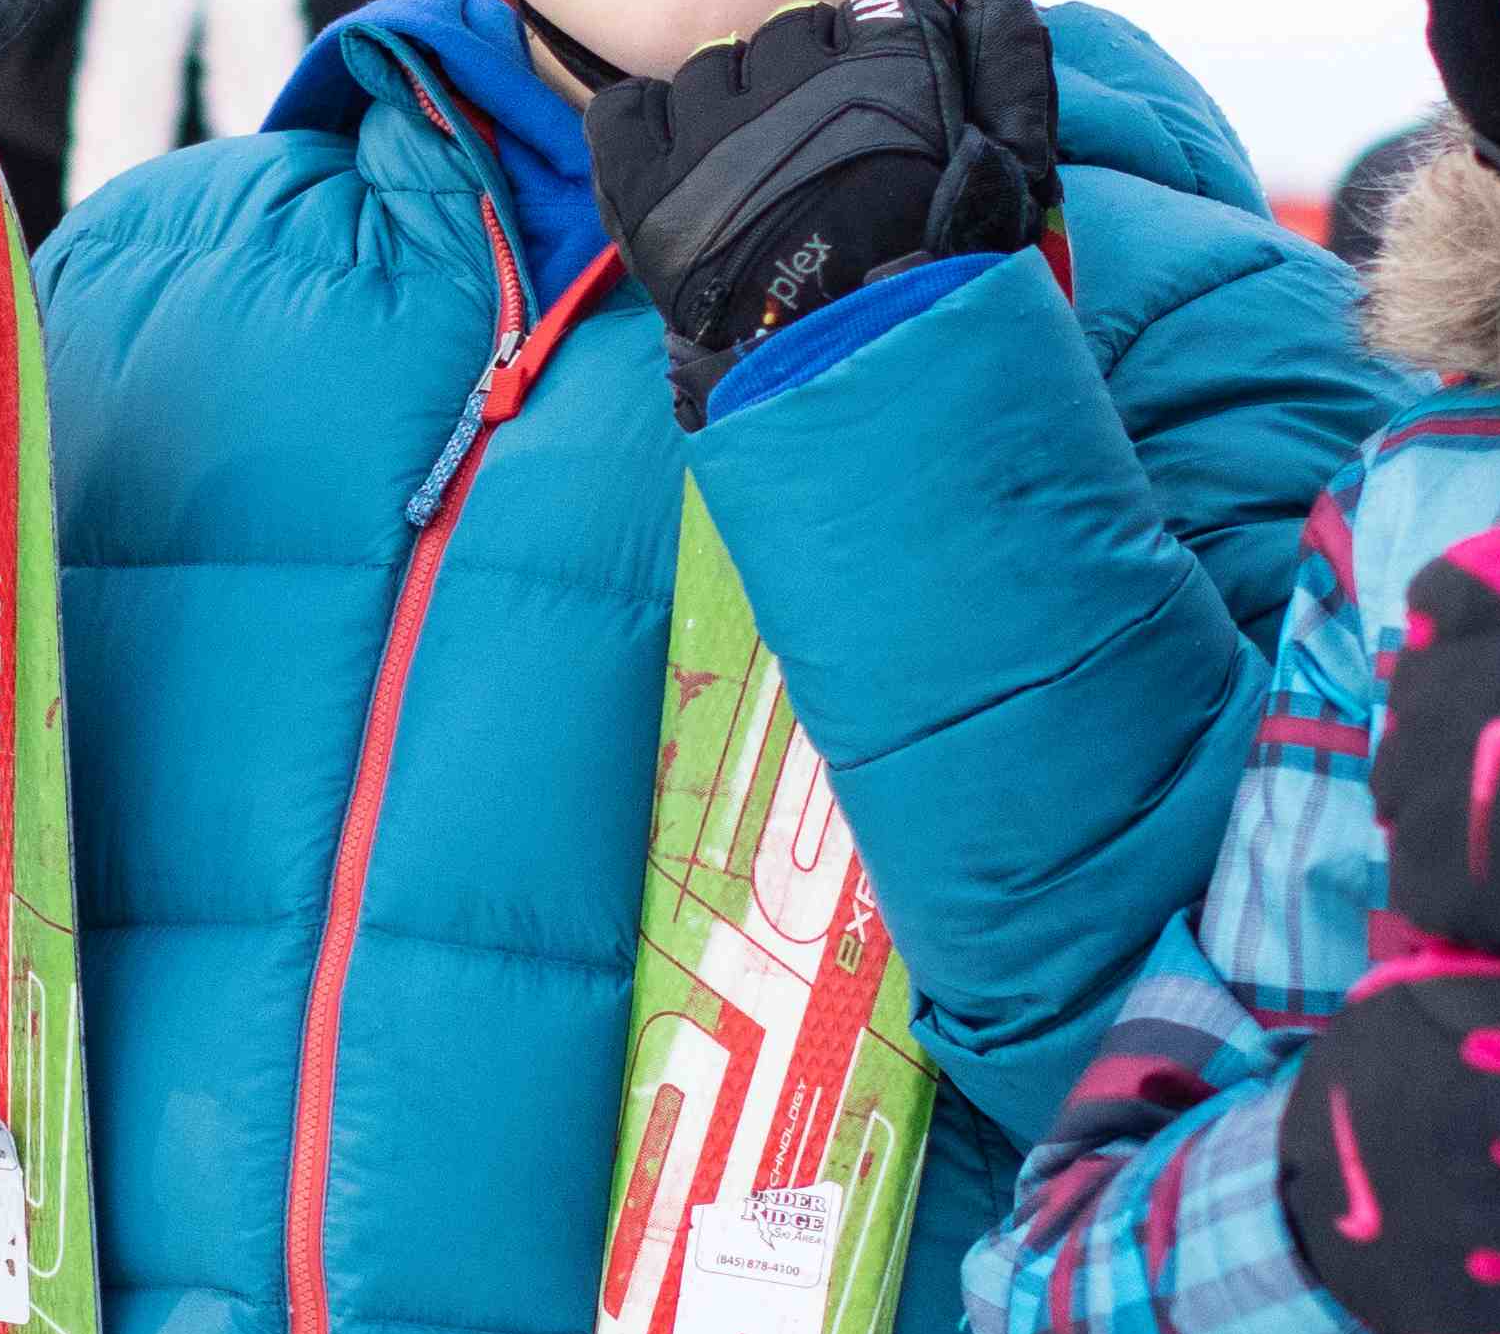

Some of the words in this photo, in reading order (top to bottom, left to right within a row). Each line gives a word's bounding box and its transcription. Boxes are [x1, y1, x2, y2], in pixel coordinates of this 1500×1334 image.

[769, 1077, 808, 1189] CHNOLOGY
[740, 1195, 826, 1232] RIDGE
[715, 1251, 745, 1267] (845)
[746, 1258, 800, 1275] 878-4100
